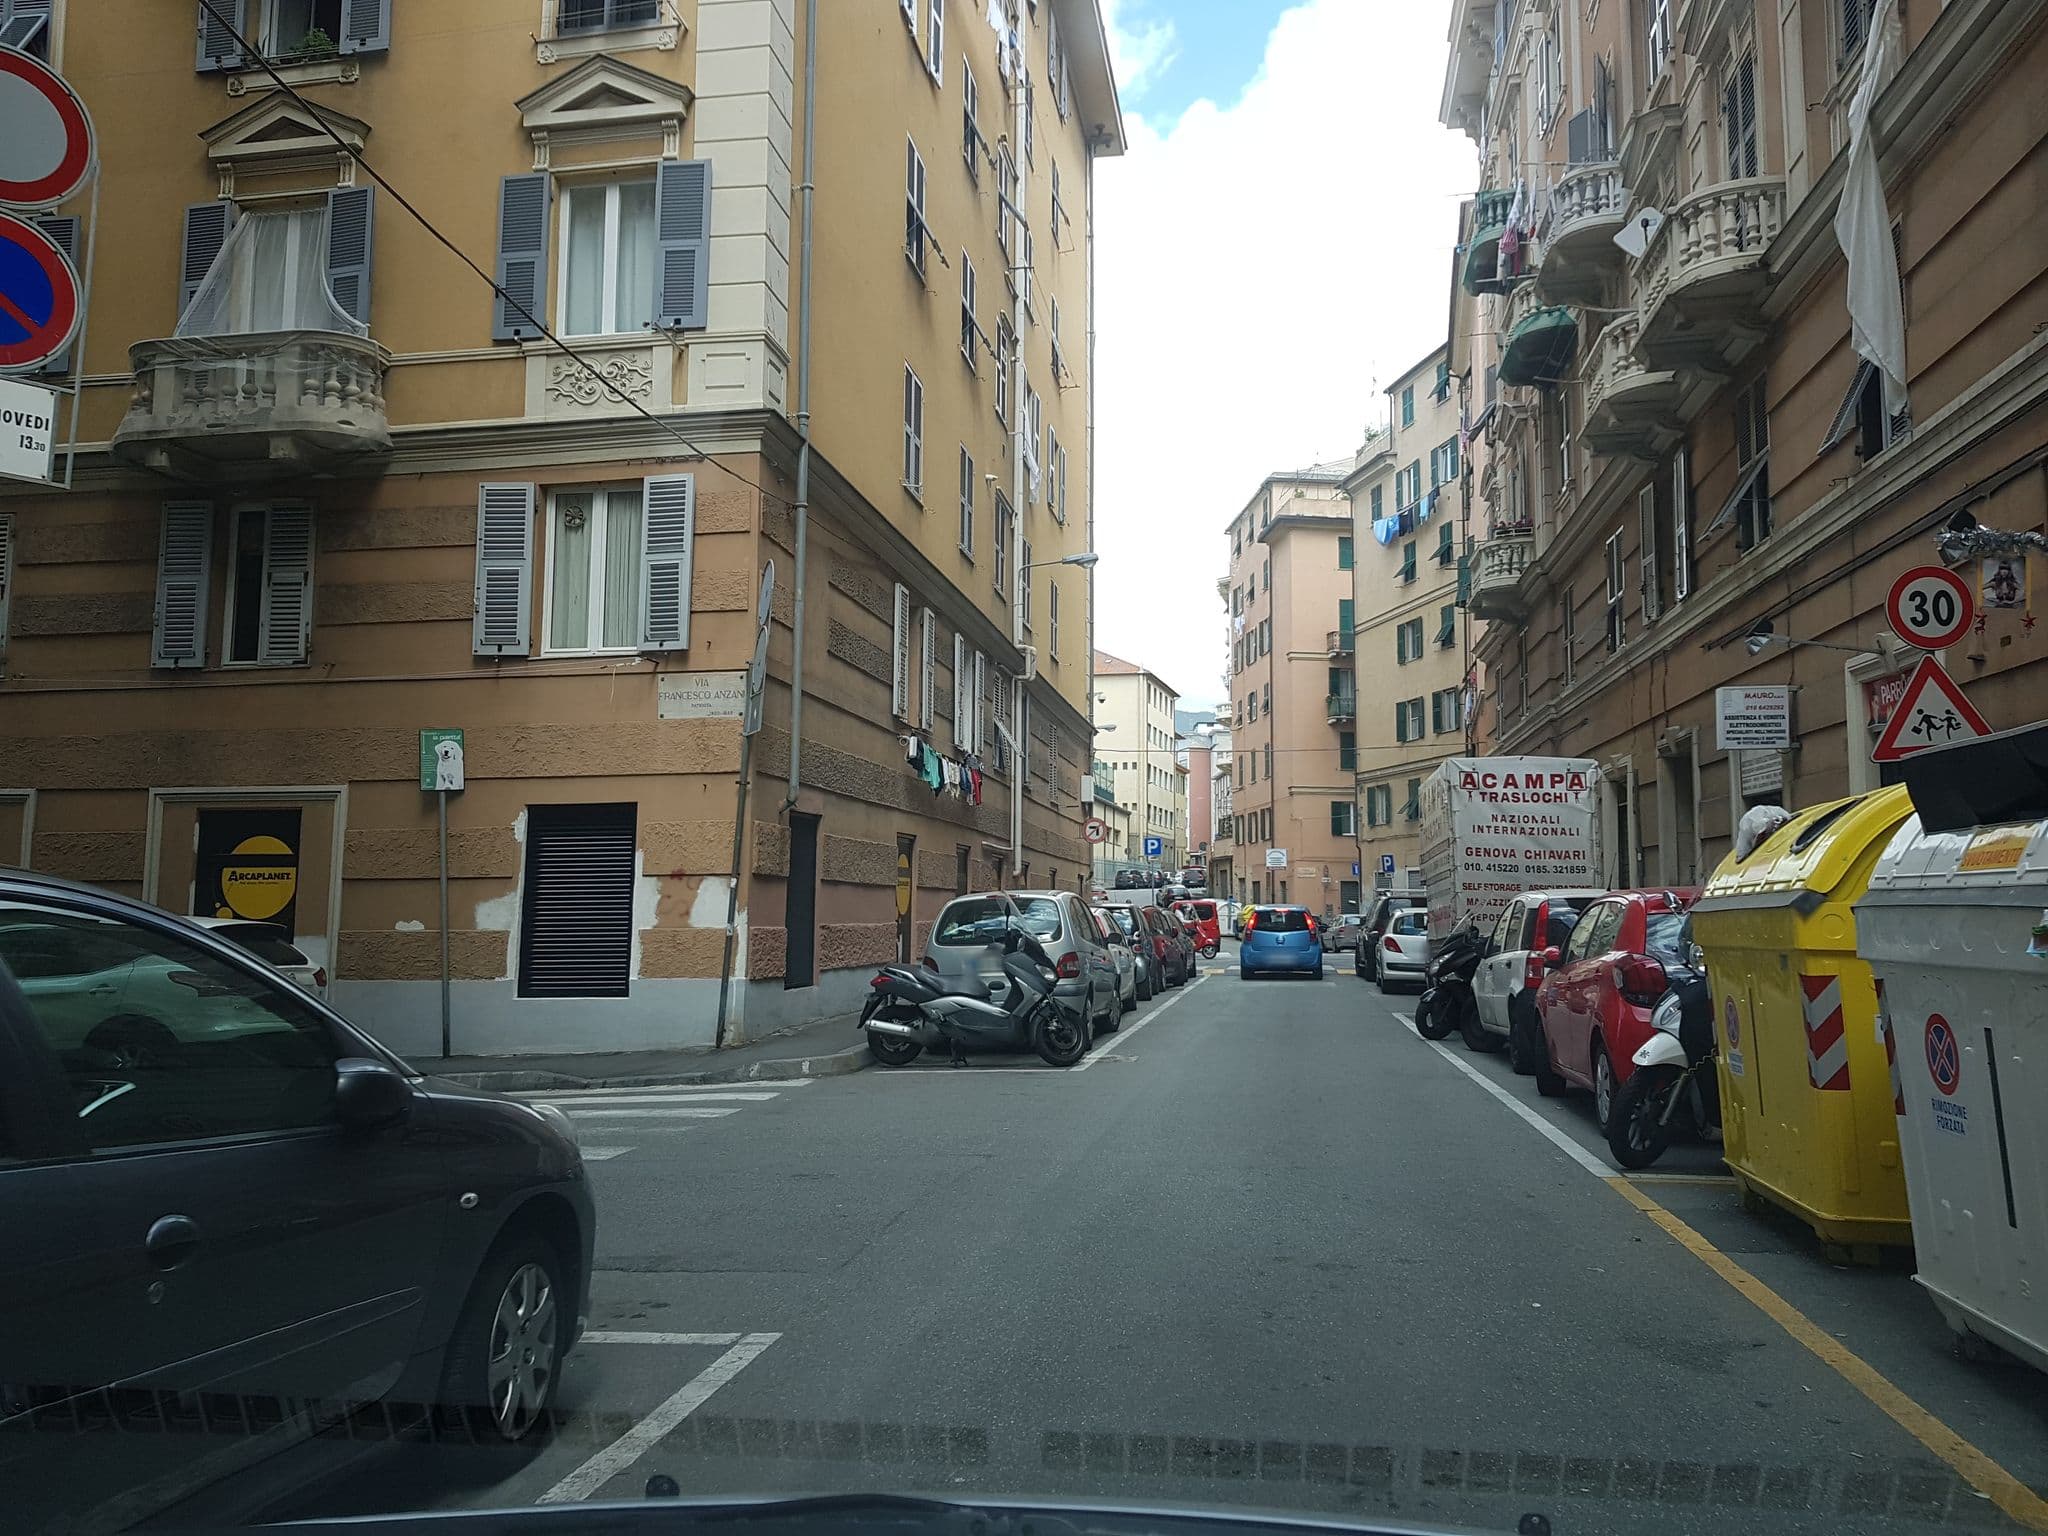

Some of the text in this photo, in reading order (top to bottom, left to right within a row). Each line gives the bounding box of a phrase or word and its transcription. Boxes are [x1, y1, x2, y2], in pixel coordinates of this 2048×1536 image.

[1908, 589, 1955, 628] 30
[694, 678, 710, 688] VIA
[658, 689, 746, 701] FRANCESCO ANZANI
[1461, 773, 1585, 790] ACAMPA
[1480, 791, 1568, 803] TRASLOCHI
[1491, 814, 1560, 824] NAZIONALI
[1472, 825, 1579, 836] INTERNAZIONALI
[1147, 840, 1158, 853] P
[1465, 847, 1586, 860] GENOVA CHIAVARI
[1383, 856, 1392, 867] P
[1464, 862, 1484, 872] 010.
[1486, 863, 1519, 873] 415220
[1553, 865, 1587, 874] 321859
[228, 870, 291, 882] ARCAPLANET
[1462, 883, 1482, 891] SELF
[1484, 883, 1521, 892] STORAGE
[1931, 1098, 1967, 1120] RIMOZIONE
[1936, 1115, 1965, 1136] FORZATA
